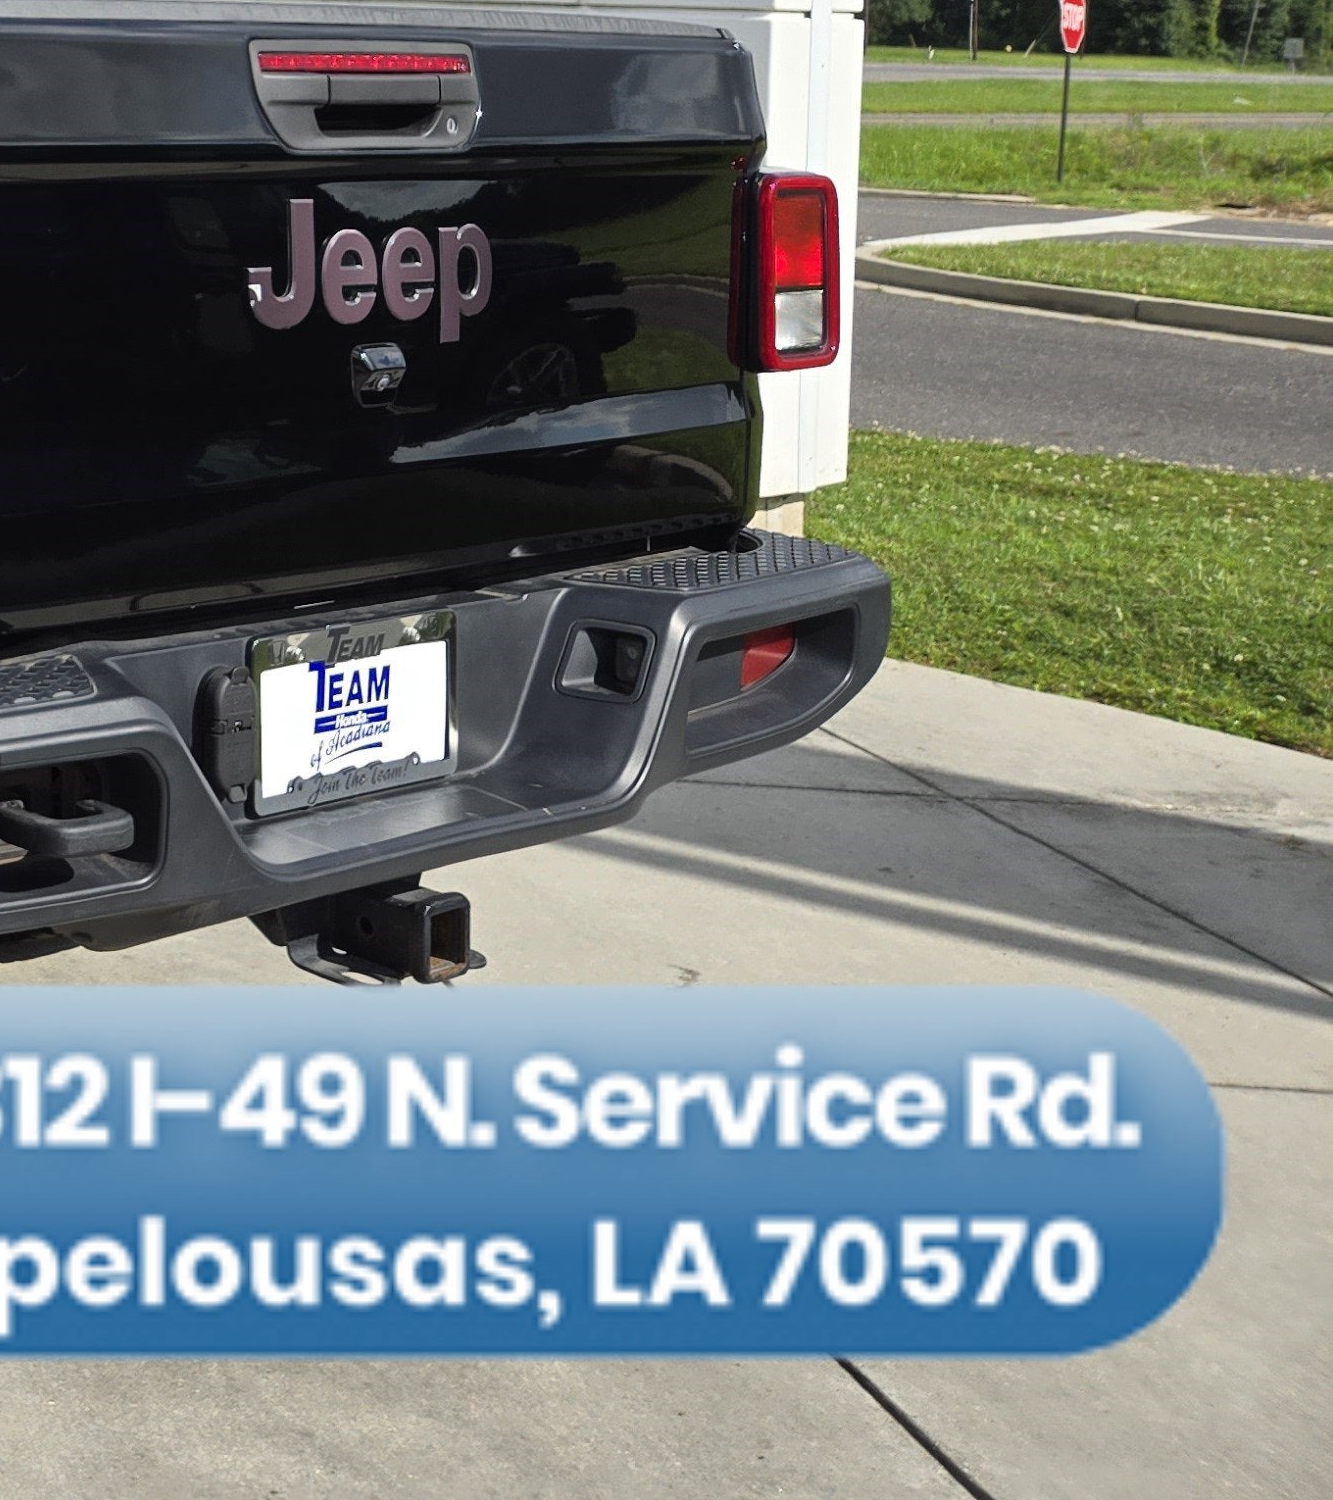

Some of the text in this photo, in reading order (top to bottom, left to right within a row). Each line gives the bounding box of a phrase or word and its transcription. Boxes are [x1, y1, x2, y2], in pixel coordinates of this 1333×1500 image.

[1062, 2, 1084, 31] STOP
[246, 198, 493, 343] Jeep
[326, 624, 385, 667] TEAM
[308, 660, 391, 713] TEAM
[335, 711, 370, 728] Honda
[310, 720, 391, 771] of Acadiana
